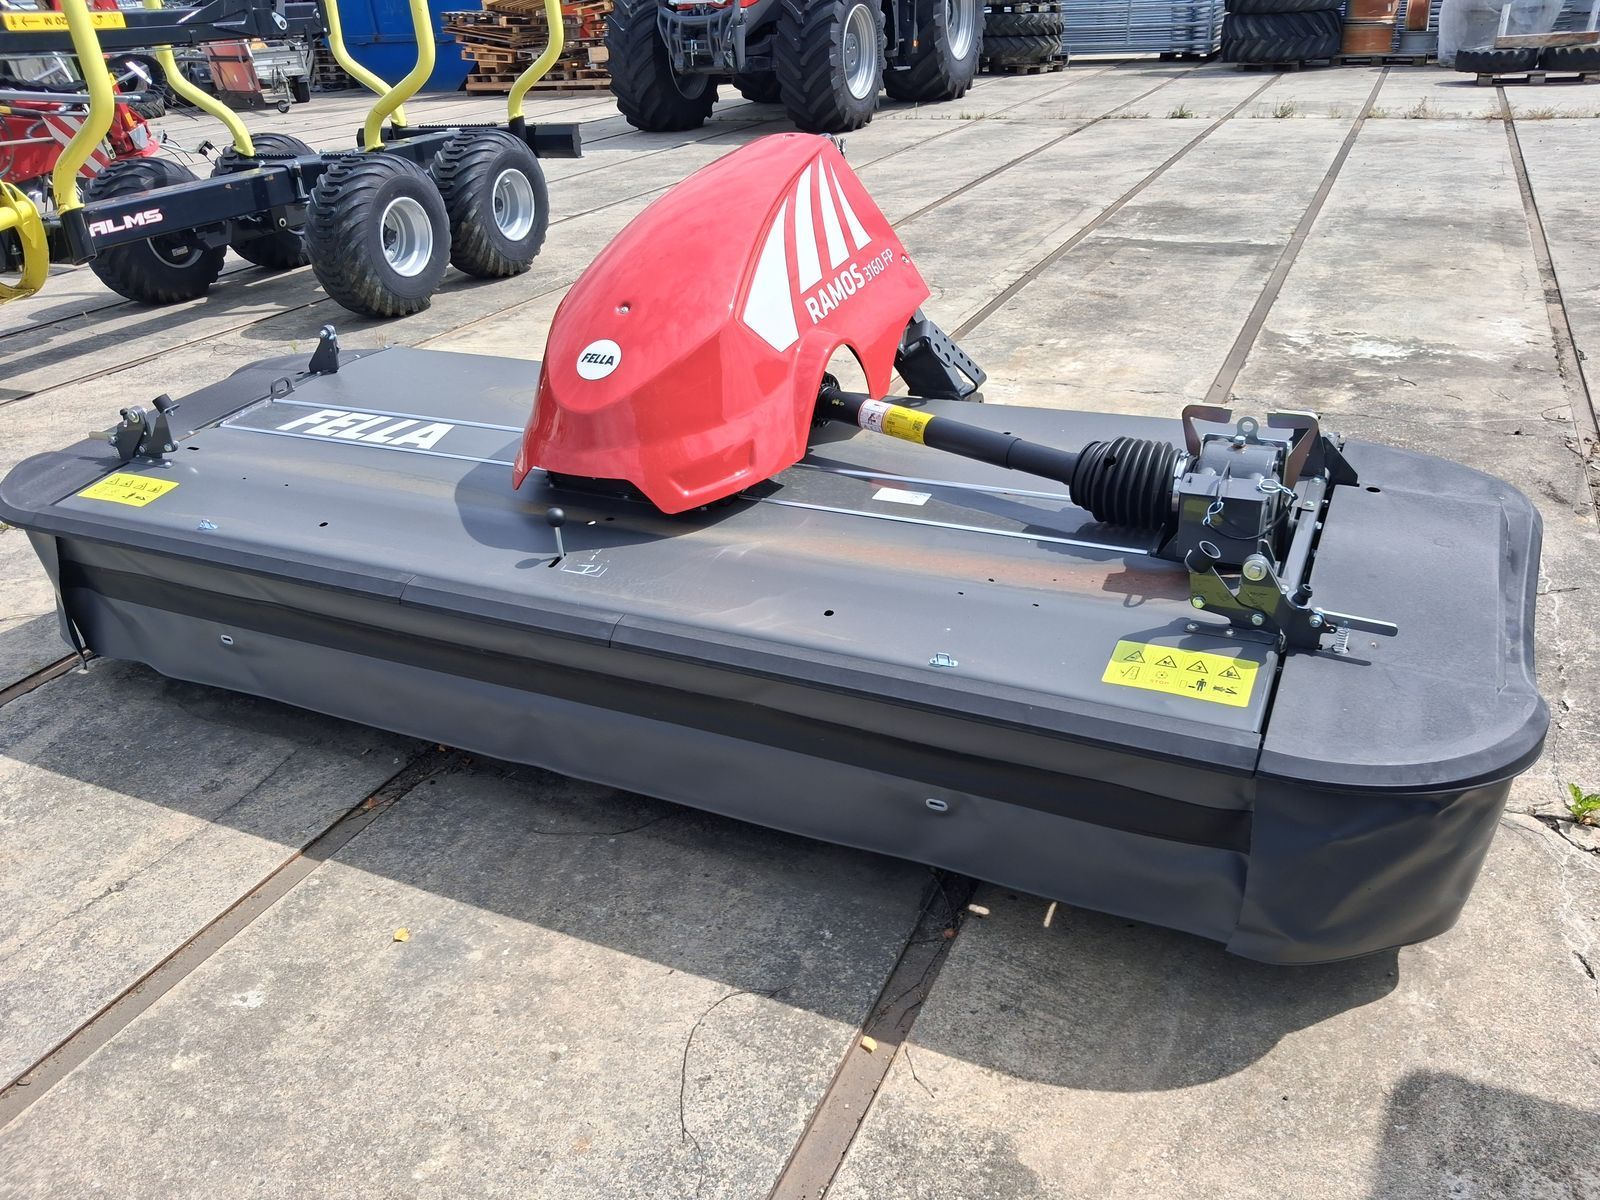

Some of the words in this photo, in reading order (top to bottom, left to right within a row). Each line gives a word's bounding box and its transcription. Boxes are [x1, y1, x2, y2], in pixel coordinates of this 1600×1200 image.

[89, 208, 163, 237] ALMS
[804, 262, 866, 325] RAMOS
[862, 257, 885, 281] 3160
[881, 248, 894, 266] FP
[581, 353, 614, 366] FELLA
[275, 409, 455, 450] FELLA
